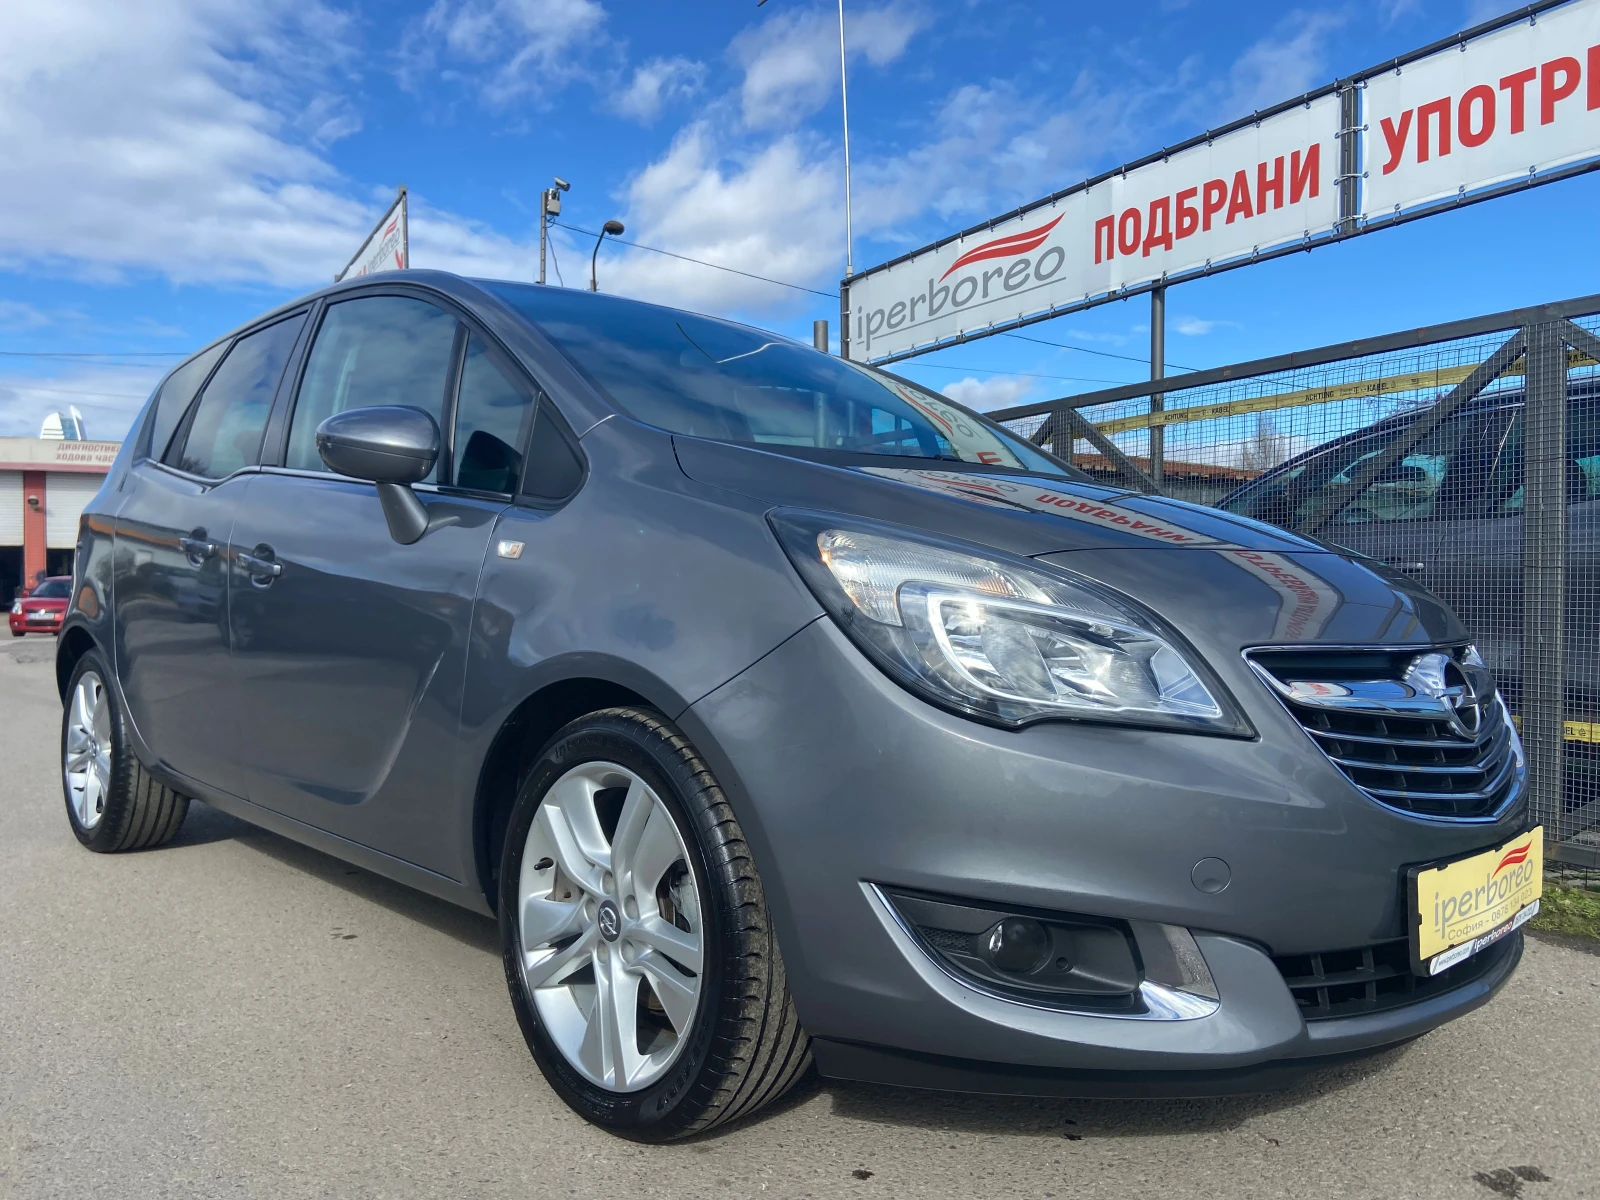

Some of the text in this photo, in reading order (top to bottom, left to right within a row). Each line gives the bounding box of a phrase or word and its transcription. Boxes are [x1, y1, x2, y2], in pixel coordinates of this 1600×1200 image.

[1095, 143, 1320, 265] ПОДБРАНИ
[857, 246, 1065, 351] iperboreo
[1305, 391, 1334, 401] ACHTUNG
[1164, 412, 1188, 421] ACHTUNG
[1434, 859, 1533, 940] iperboreo
[1447, 922, 1484, 941] София
[1474, 921, 1513, 952] iperboreo
